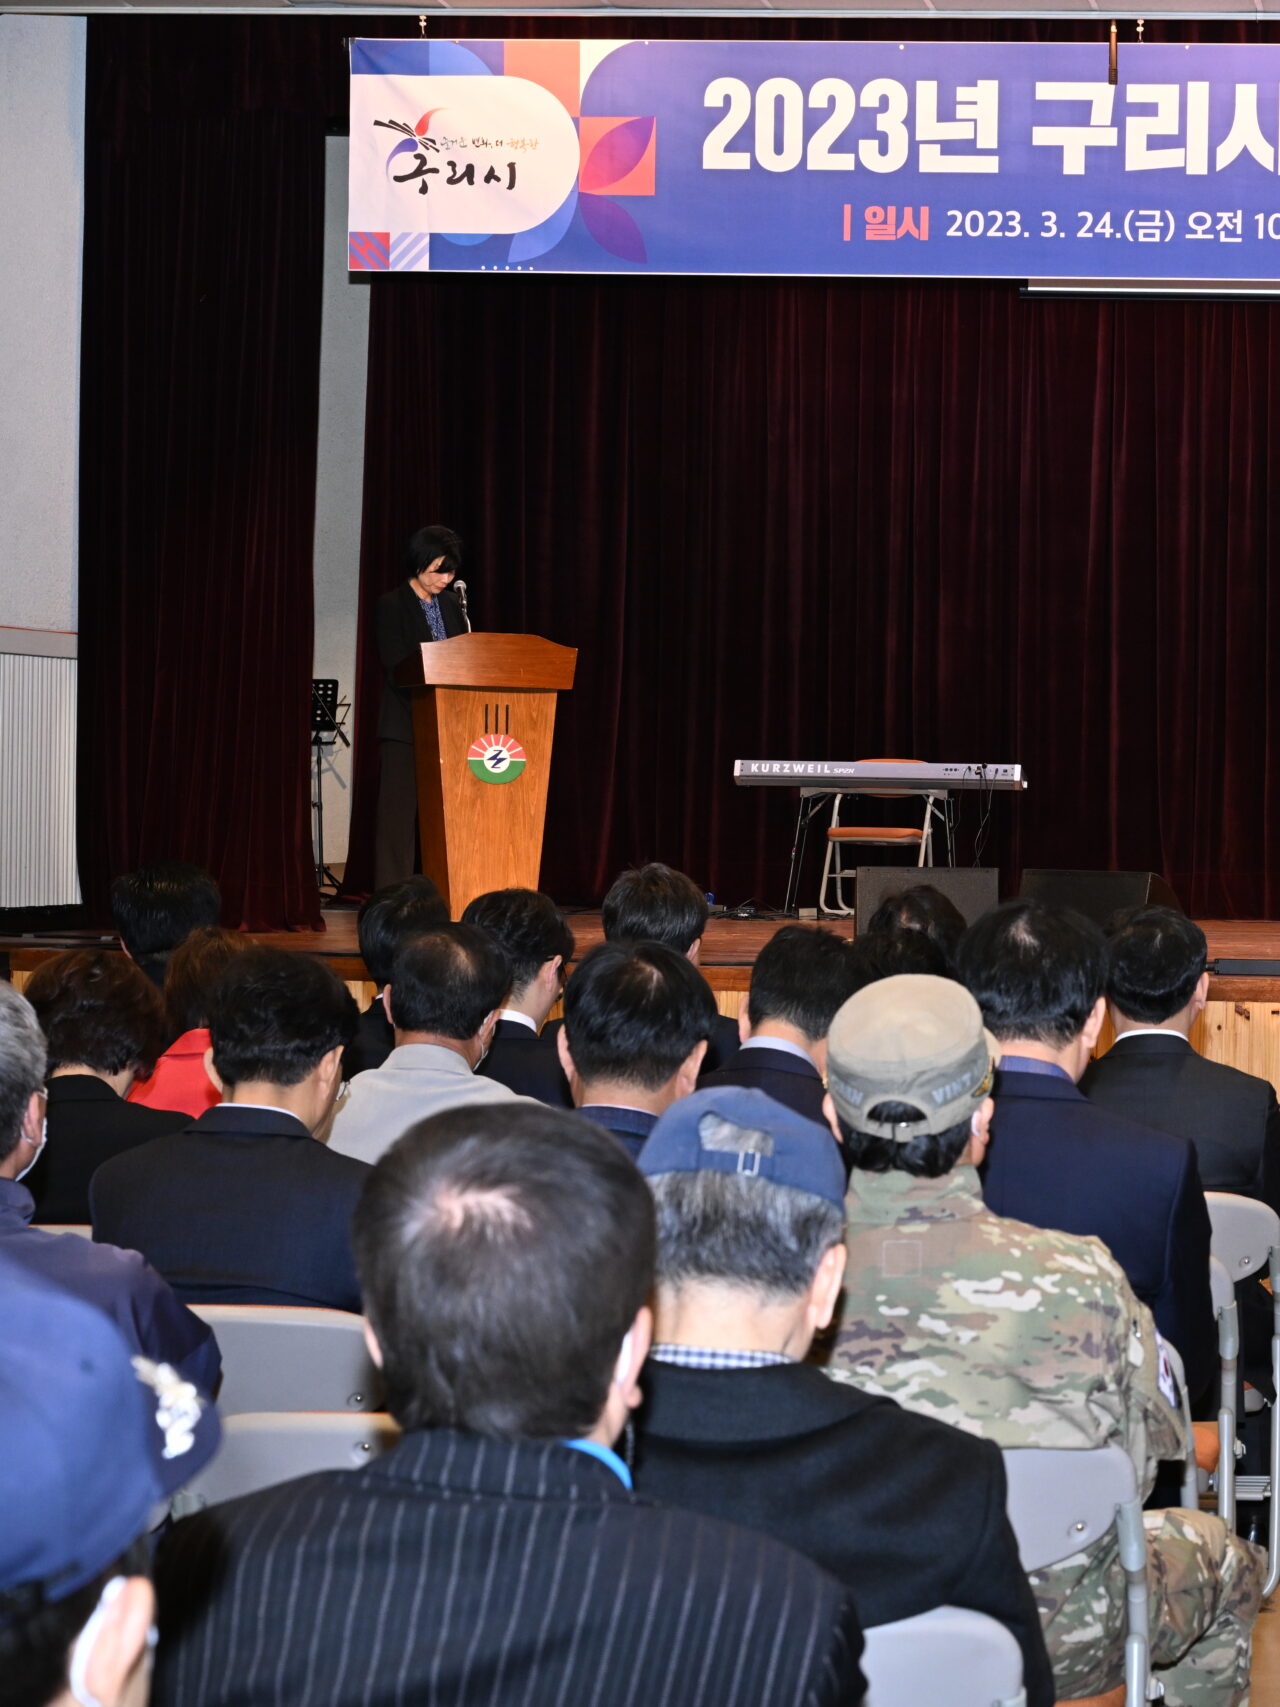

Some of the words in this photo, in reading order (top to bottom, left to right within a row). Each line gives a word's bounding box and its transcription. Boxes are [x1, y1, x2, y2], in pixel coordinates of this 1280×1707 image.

[702, 76, 1000, 174] 2023년
[393, 153, 516, 195] 구리시
[864, 205, 929, 241] 일시
[946, 209, 1030, 238] 2023.
[1040, 210, 1066, 238] 3.
[1076, 209, 1175, 243] 24.(금)
[1185, 209, 1243, 243] 오전
[751, 763, 831, 774] KURZWEIL
